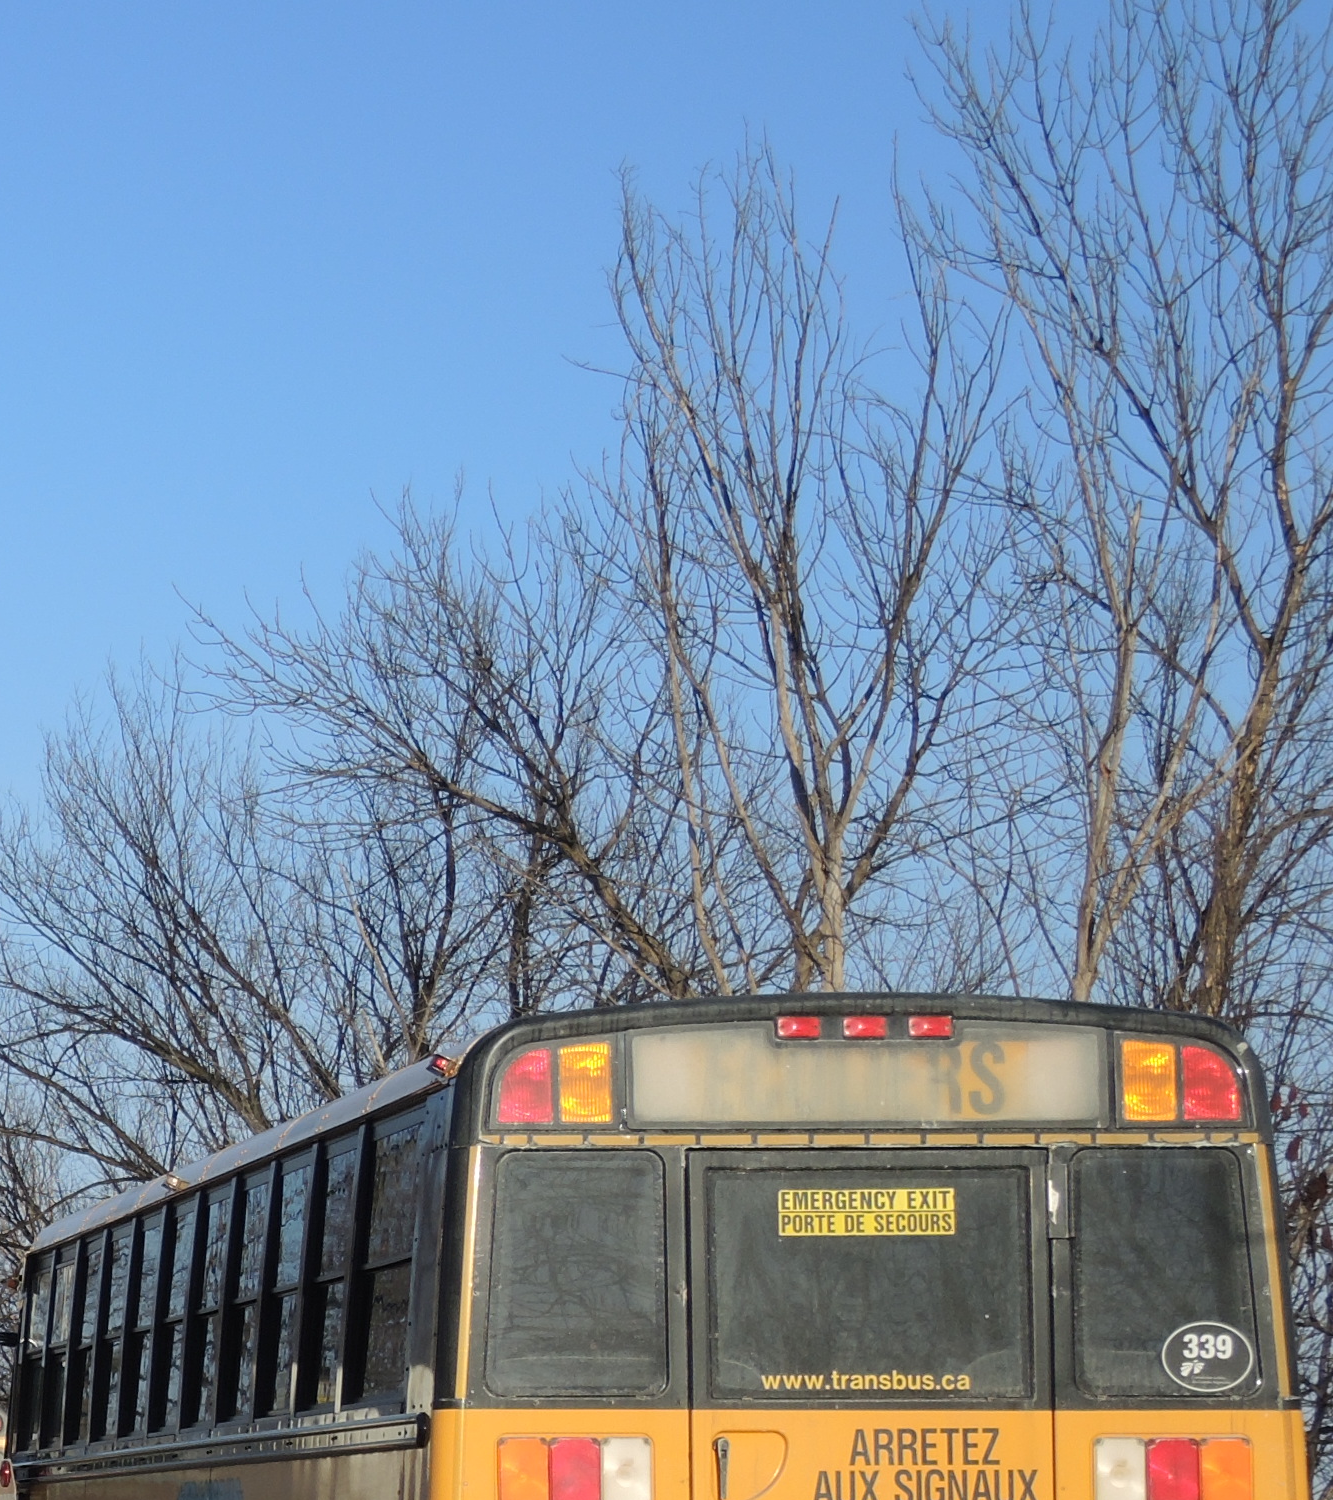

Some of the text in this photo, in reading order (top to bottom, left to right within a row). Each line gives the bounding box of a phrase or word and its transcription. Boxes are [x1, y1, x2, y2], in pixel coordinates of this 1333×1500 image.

[782, 1190, 951, 1210] EMERGENCY EXIT
[782, 1213, 952, 1233] PORTE DE SECOURS
[1183, 1334, 1232, 1359] 339
[761, 1369, 971, 1390] www.transbus.ca
[849, 1428, 1000, 1466] ARRETEZ
